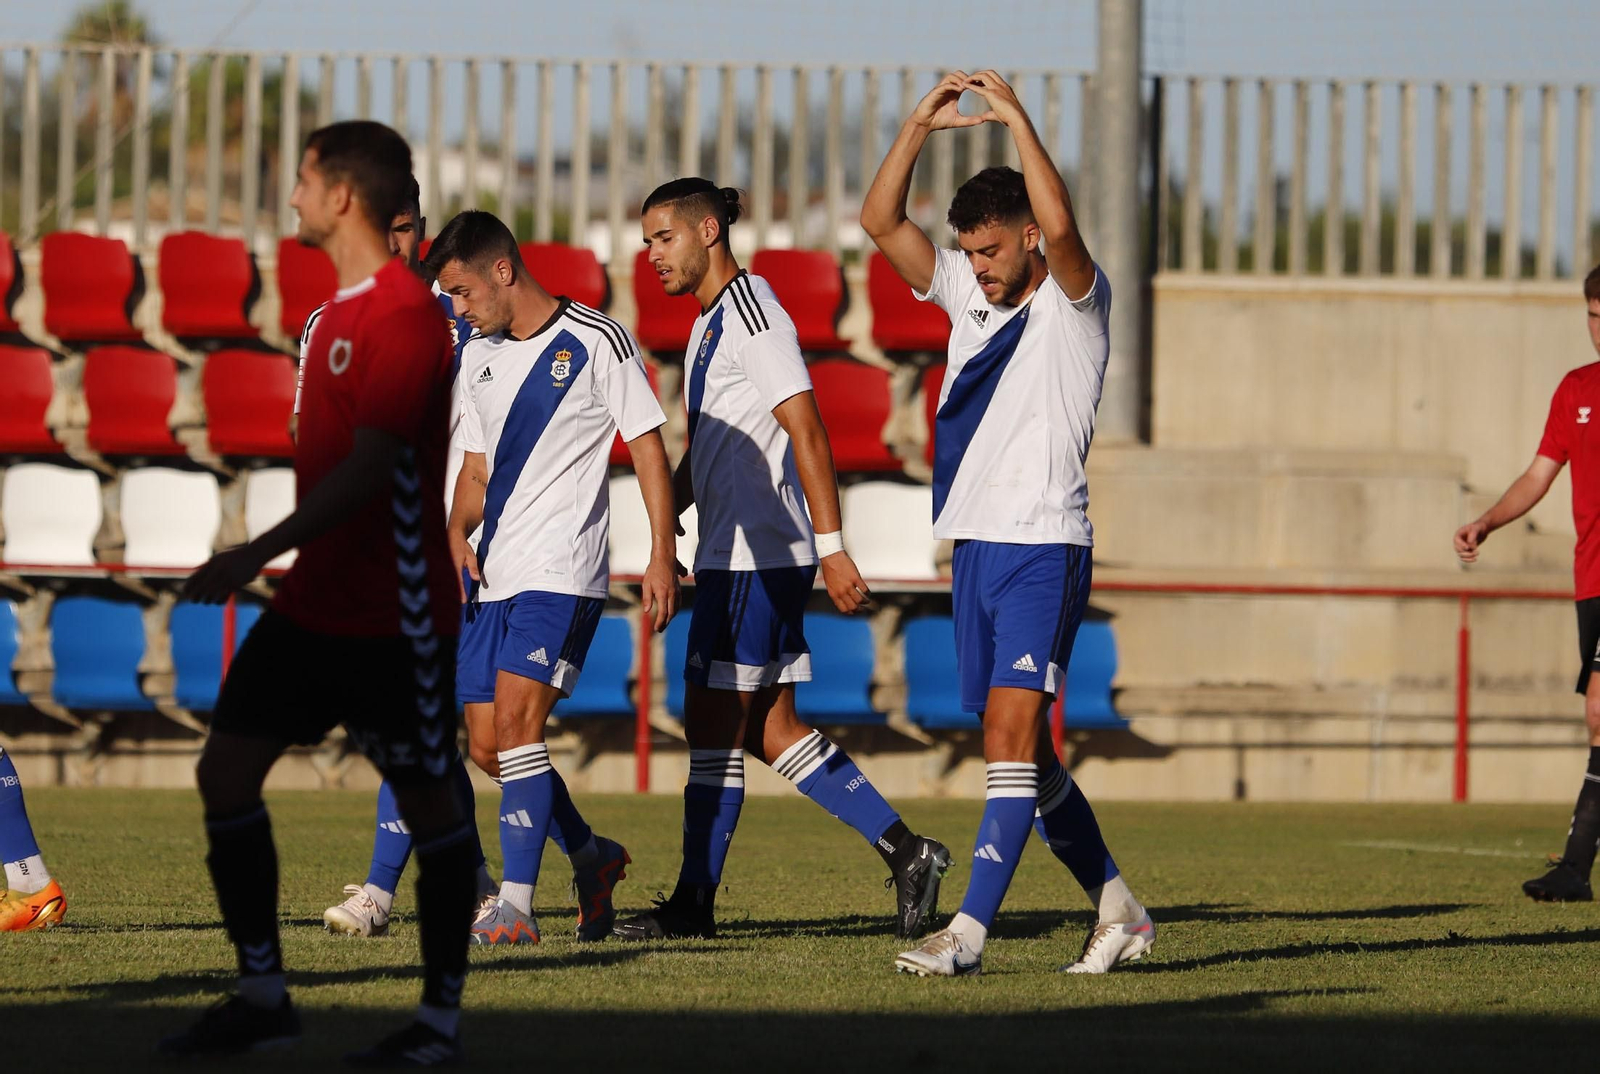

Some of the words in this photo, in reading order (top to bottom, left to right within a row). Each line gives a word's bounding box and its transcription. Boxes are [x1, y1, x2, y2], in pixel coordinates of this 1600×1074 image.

[967, 310, 985, 329] adidas
[527, 654, 549, 666] adidas
[1012, 663, 1038, 672] adidas
